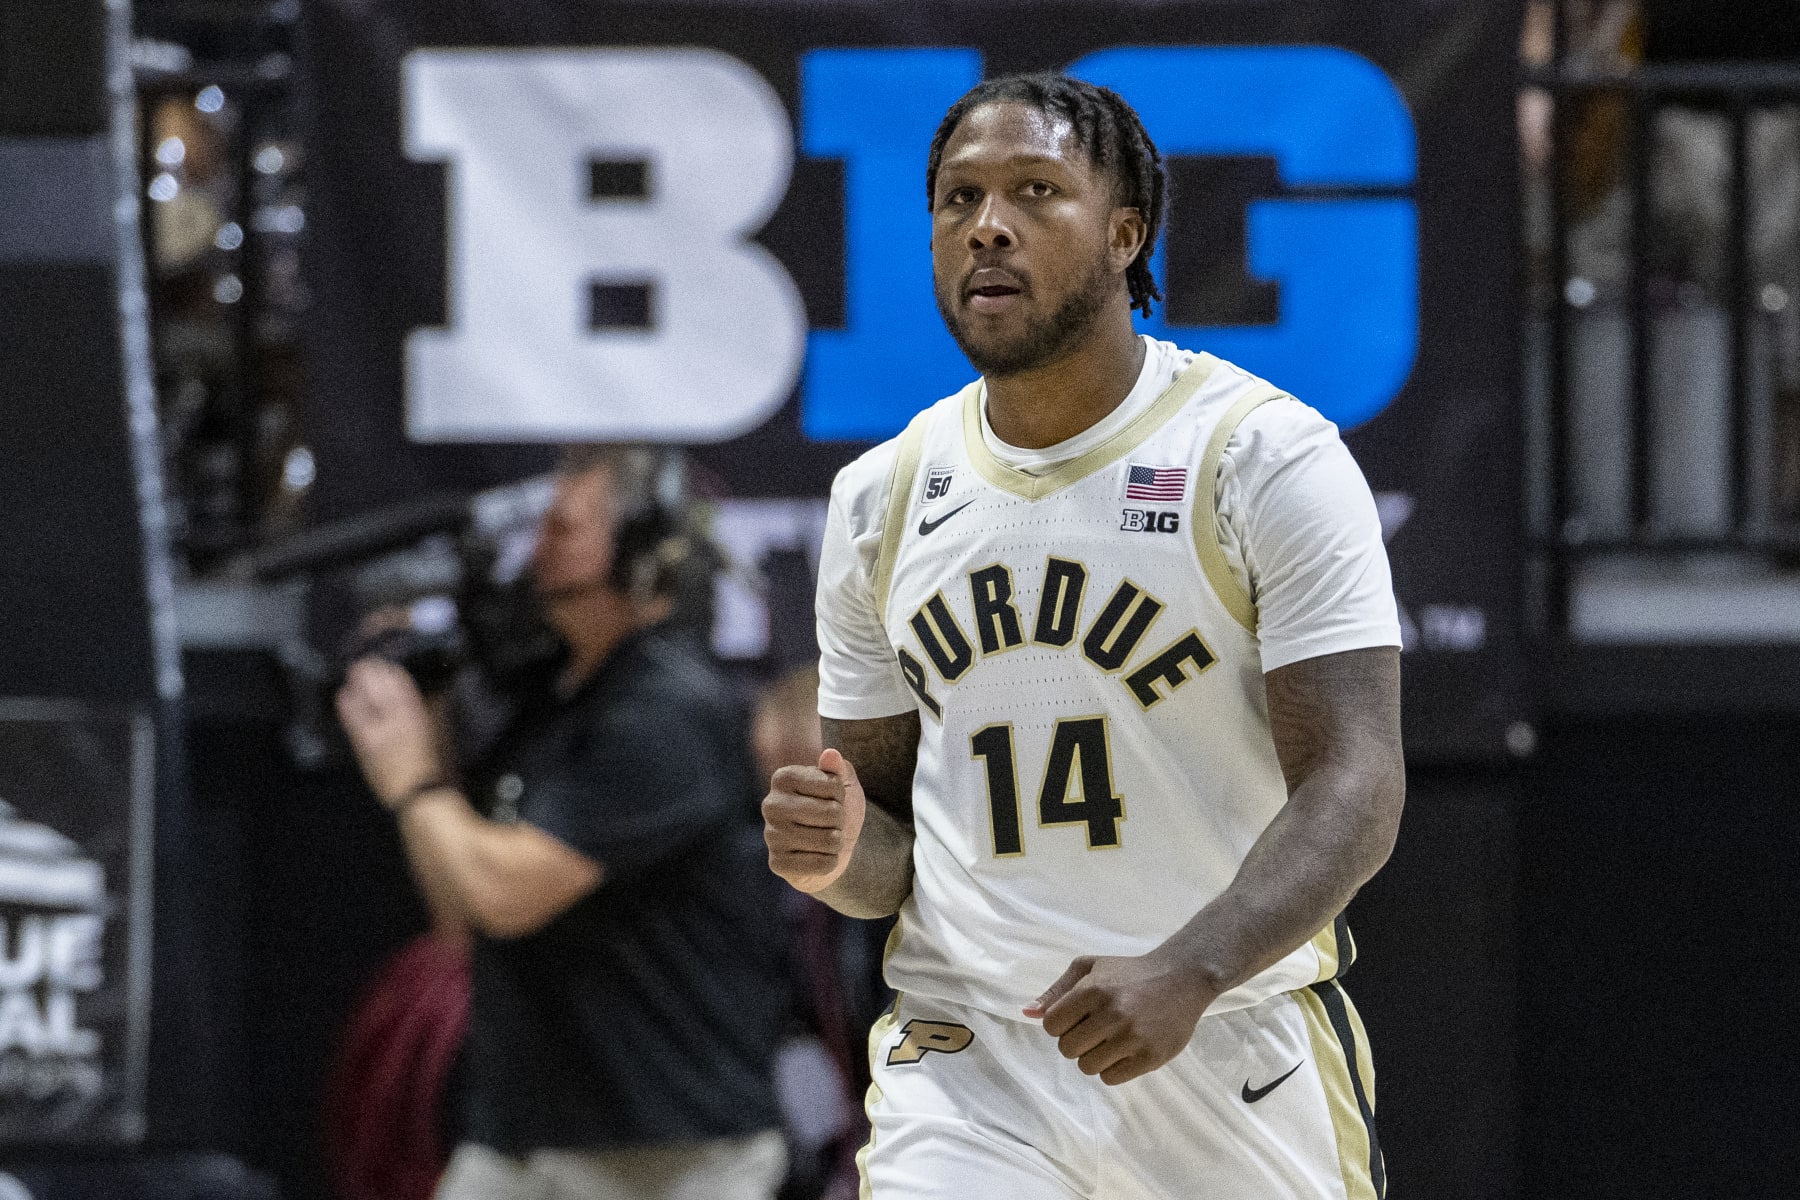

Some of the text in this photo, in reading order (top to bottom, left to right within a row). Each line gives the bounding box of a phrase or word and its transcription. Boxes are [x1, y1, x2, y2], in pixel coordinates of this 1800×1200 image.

[926, 475, 953, 500] 50
[898, 554, 1219, 727] PURDUE
[968, 713, 1127, 859] 14
